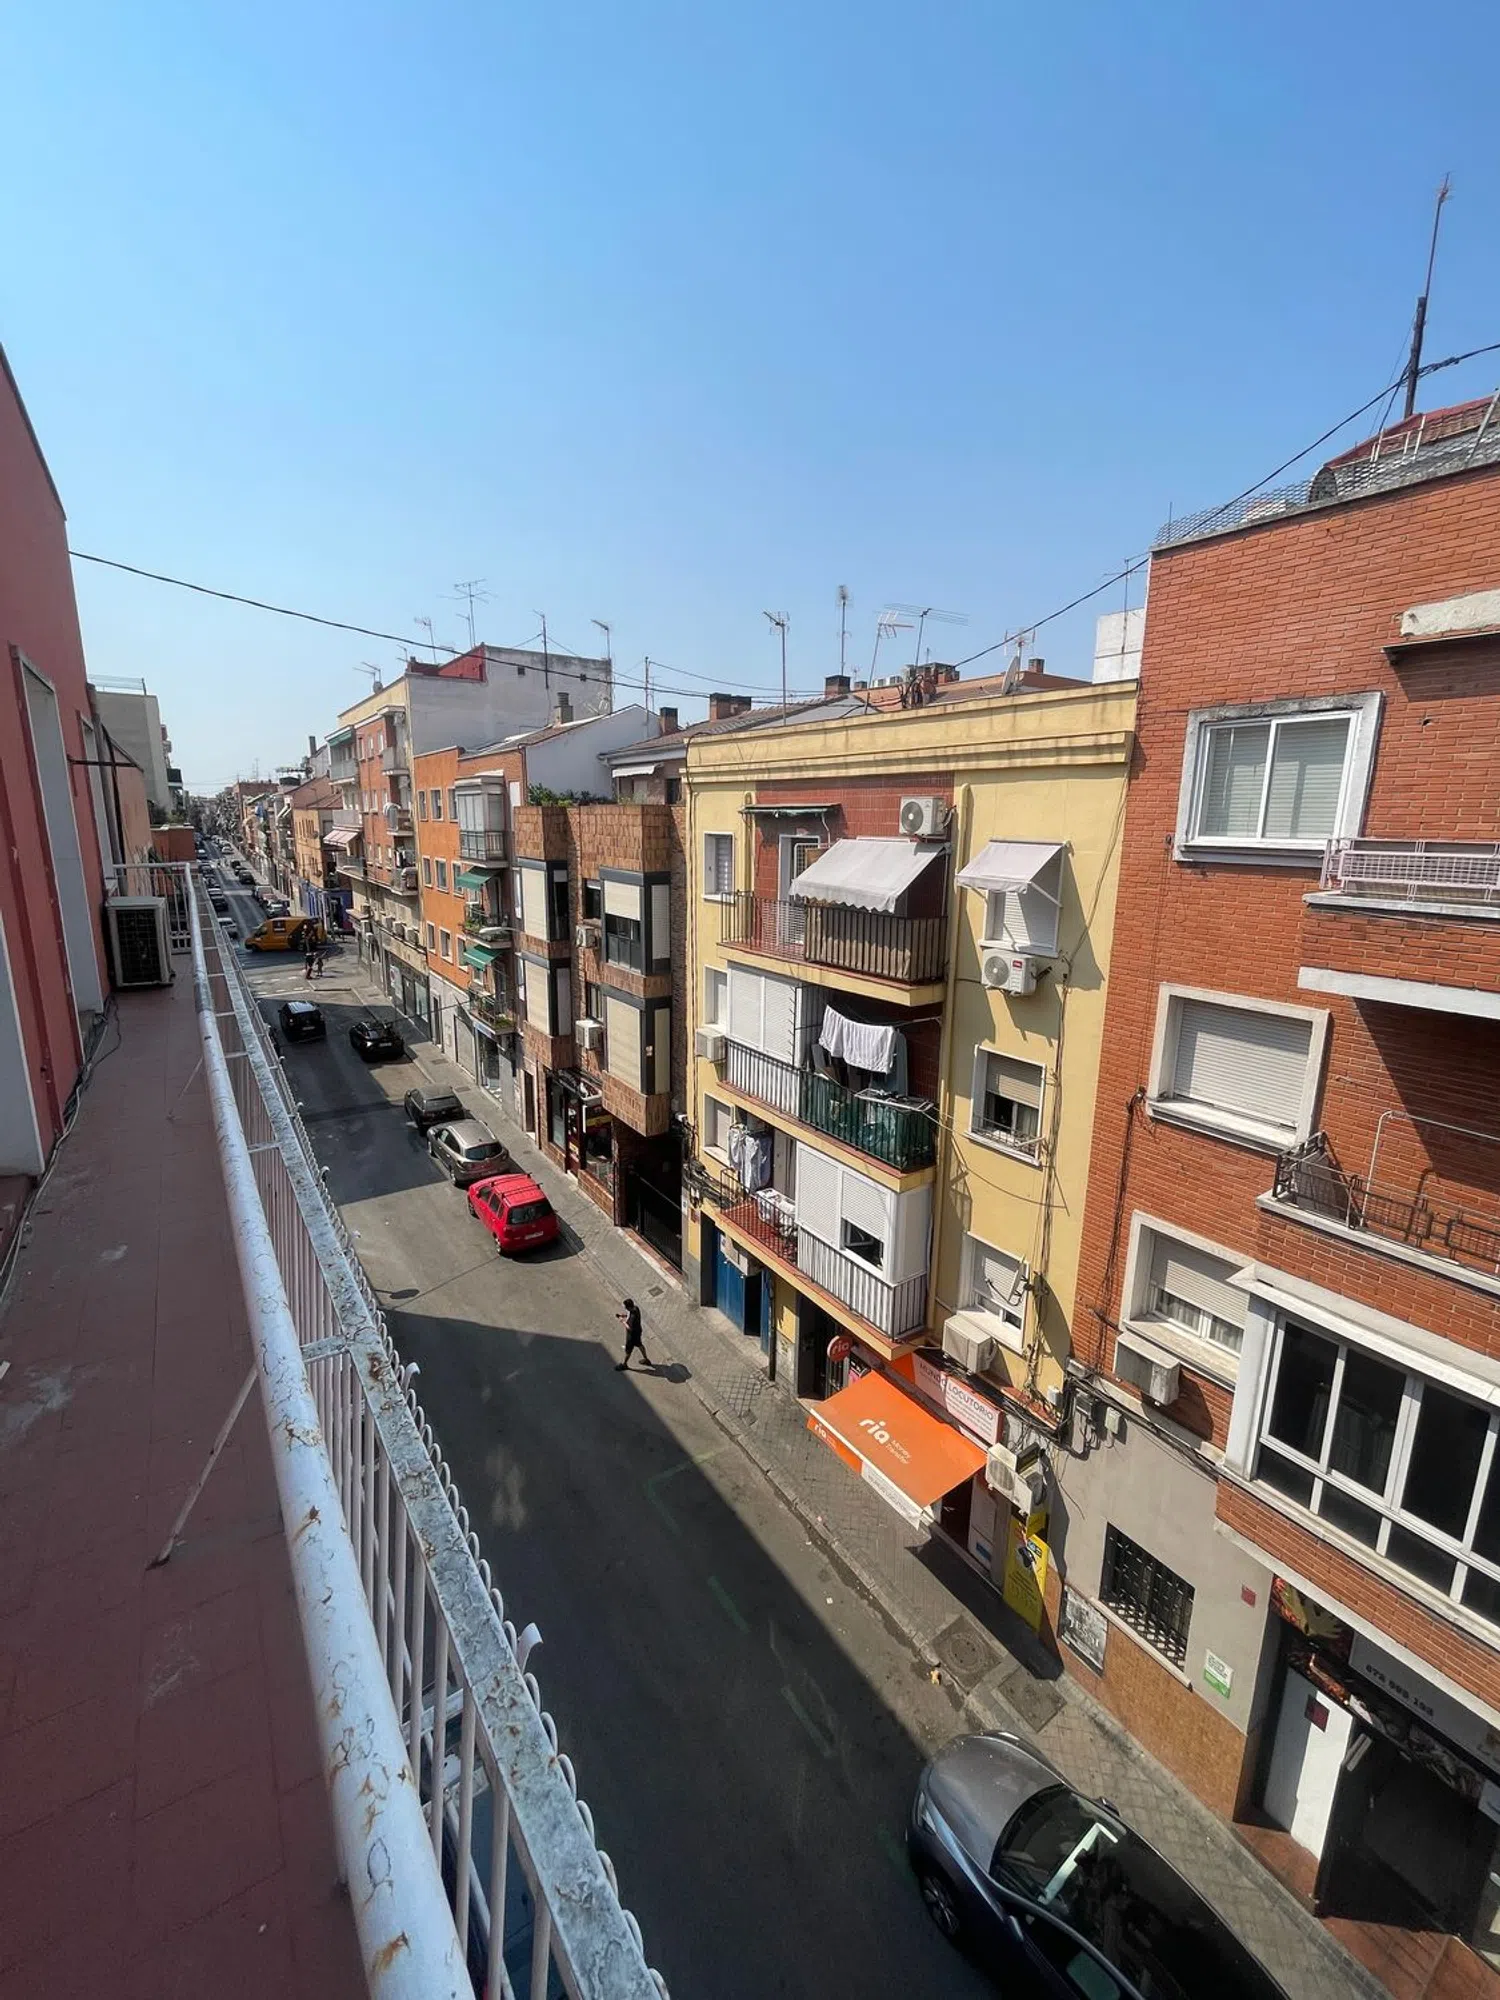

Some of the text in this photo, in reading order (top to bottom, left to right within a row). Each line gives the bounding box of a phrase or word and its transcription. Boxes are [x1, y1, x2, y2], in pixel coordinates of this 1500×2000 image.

[832, 1340, 850, 1354] ria
[948, 1382, 994, 1421] LOCUTORIO
[814, 1423, 828, 1438] ria
[858, 1419, 890, 1445] ria
